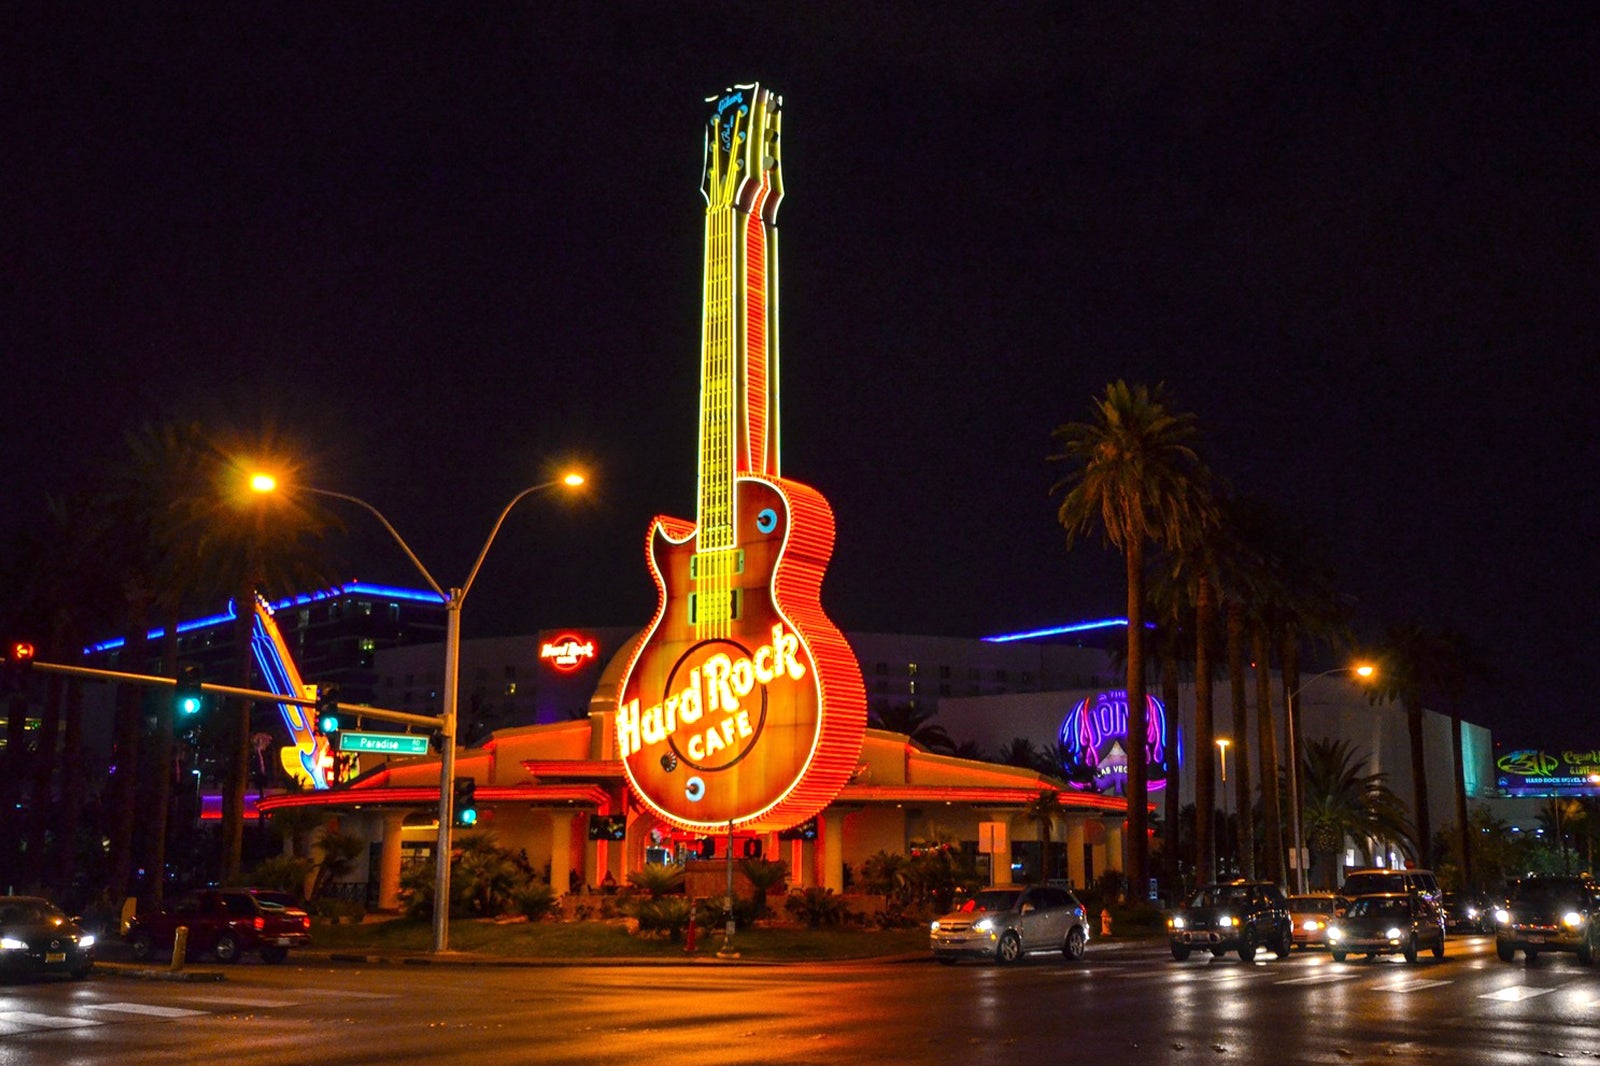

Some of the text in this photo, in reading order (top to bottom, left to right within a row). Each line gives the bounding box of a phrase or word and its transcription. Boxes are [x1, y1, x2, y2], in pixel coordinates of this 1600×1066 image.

[616, 622, 806, 758] Hard Rock
[360, 737, 399, 750] Paradise
[688, 710, 752, 761] CAFE
